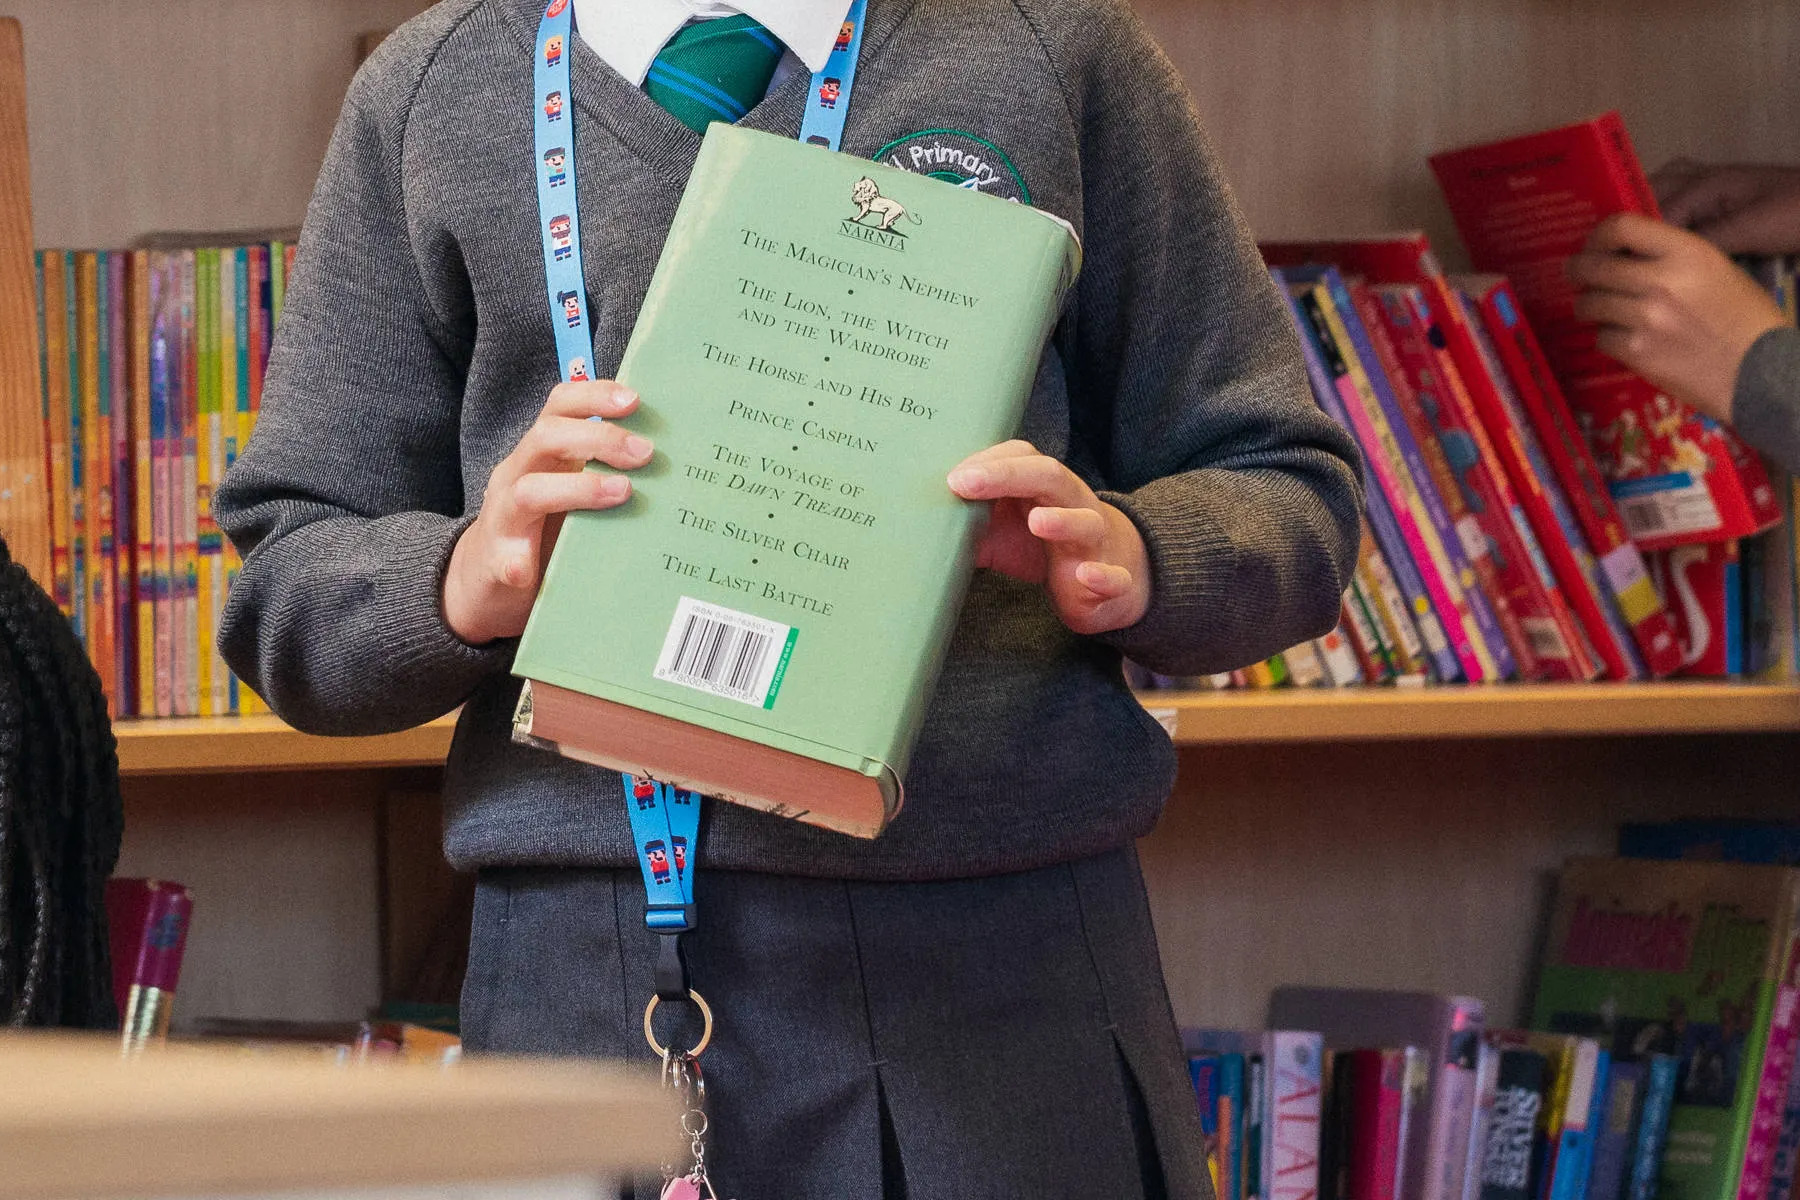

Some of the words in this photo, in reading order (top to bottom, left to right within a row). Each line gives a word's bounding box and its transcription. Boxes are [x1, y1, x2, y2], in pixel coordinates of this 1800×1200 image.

[908, 141, 1000, 186] Primary
[838, 220, 906, 251] NARNIA
[740, 228, 780, 255] THE
[785, 242, 893, 286] MAGICIAN'S
[899, 274, 981, 310] NEPHEW
[737, 307, 777, 328] AND
[783, 319, 821, 341] THE
[829, 328, 932, 371] WARDROBE
[738, 277, 777, 304] THE
[783, 292, 832, 321] LION,
[841, 310, 878, 332] THE
[887, 319, 950, 351] WITCH
[702, 342, 741, 368] THE
[748, 356, 809, 386] HORSE
[813, 377, 853, 398] AND
[859, 386, 893, 408] HIS
[899, 396, 940, 421] BOY
[727, 399, 796, 432] PRINCE
[801, 419, 879, 453] CASPIAN
[684, 464, 721, 486] THE
[727, 473, 786, 502] DAWN
[791, 490, 877, 529] TREADER
[712, 443, 752, 469] THE
[760, 456, 834, 492] VOYAGE
[839, 482, 865, 500] OF
[677, 507, 717, 535] THE
[722, 521, 786, 552] SILVER
[793, 541, 851, 571] CHAIR
[662, 553, 701, 578] THE
[707, 567, 756, 594] LAST
[761, 582, 835, 617] BATTLE
